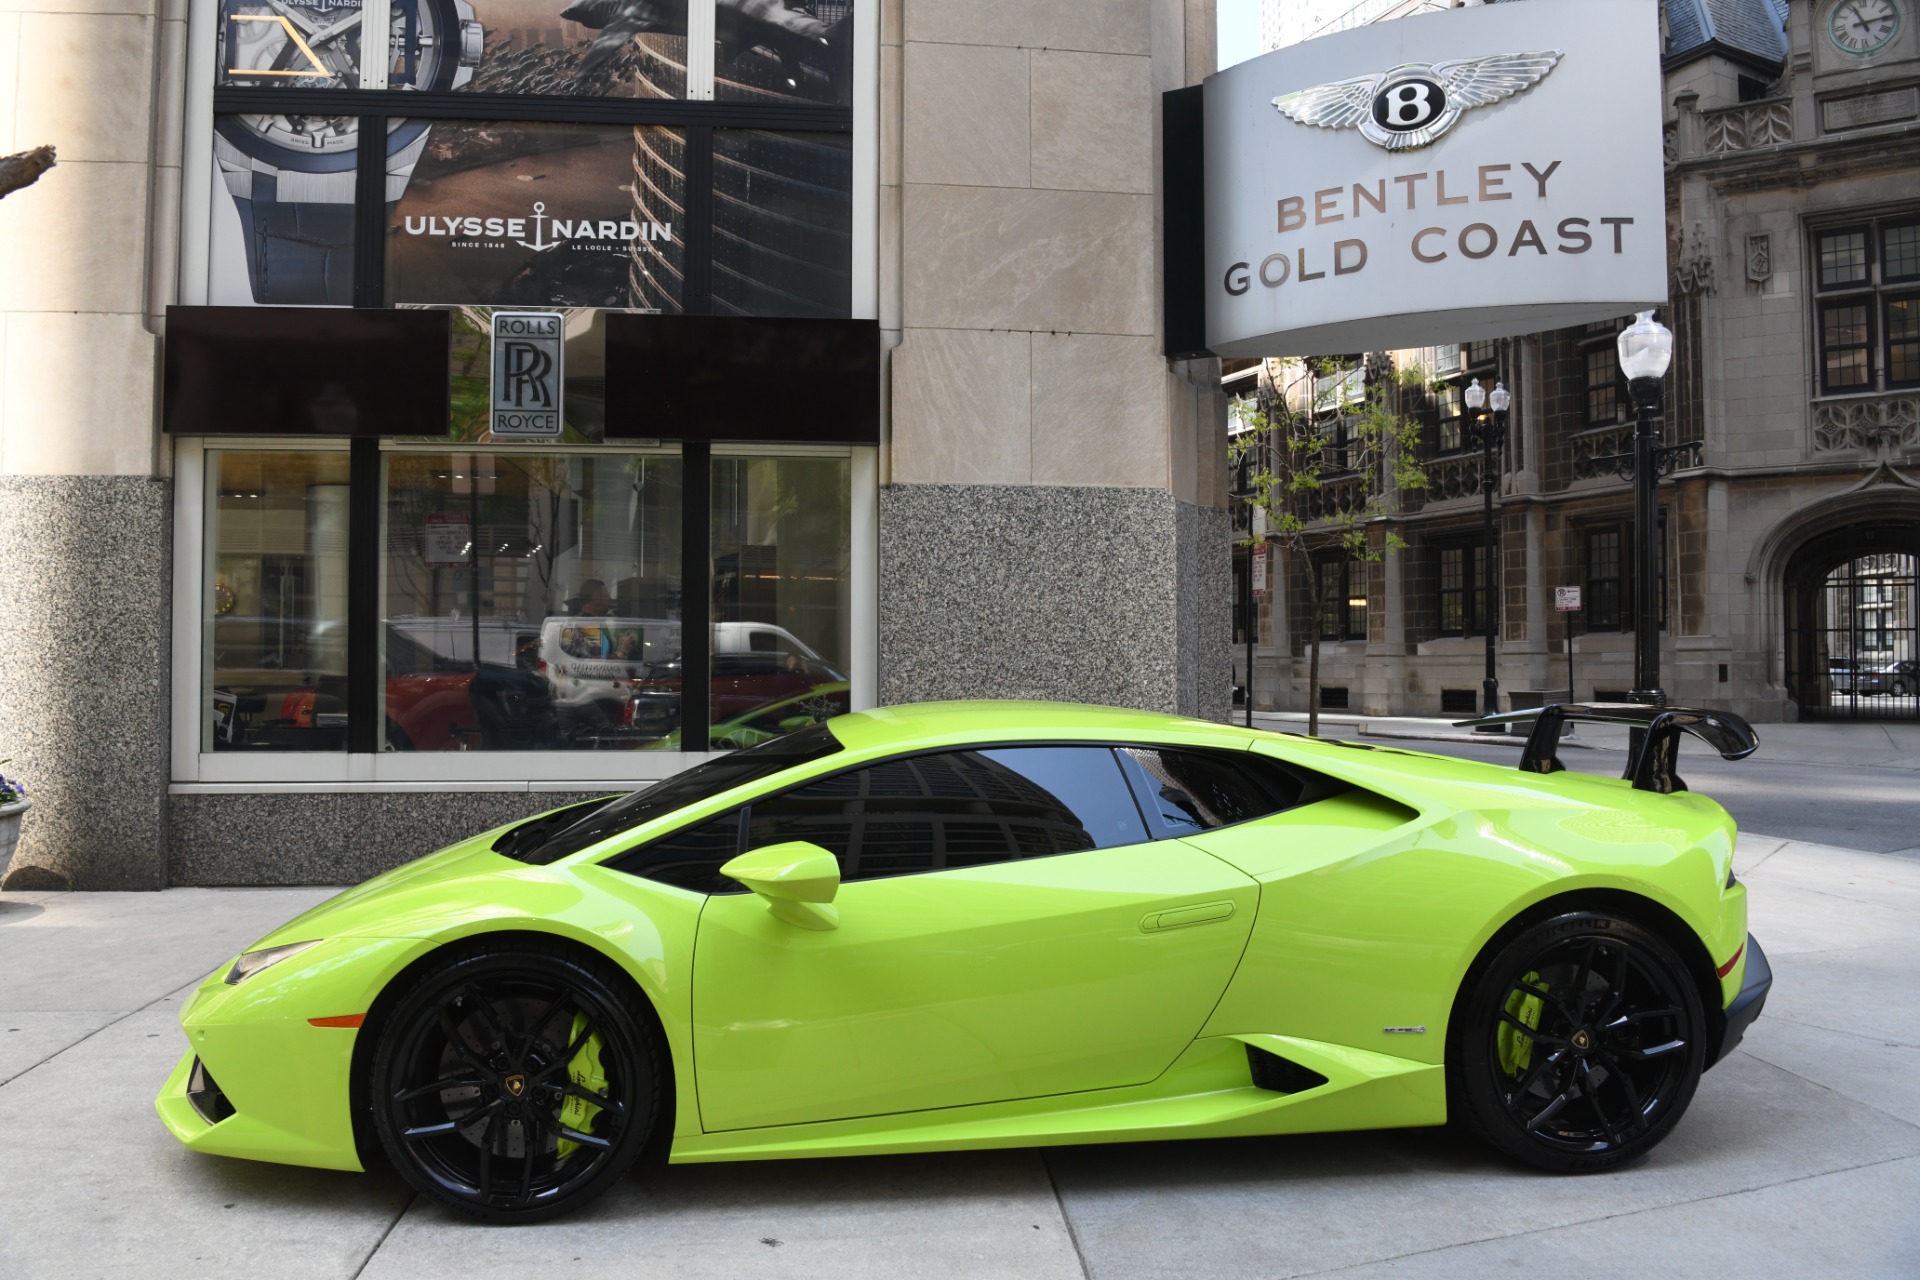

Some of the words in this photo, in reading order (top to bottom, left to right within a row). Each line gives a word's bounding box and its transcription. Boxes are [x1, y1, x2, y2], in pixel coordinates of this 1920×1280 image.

[1385, 83, 1431, 126] B
[1277, 160, 1562, 233] BENTLEY
[405, 215, 526, 238] ULYSSE
[551, 219, 672, 242] NARDIN
[622, 245, 653, 253] SUISSE
[1223, 238, 1368, 297] GOLD
[1411, 216, 1635, 264] COAST
[499, 320, 556, 335] ROLLS
[497, 414, 555, 429] ROYCE
